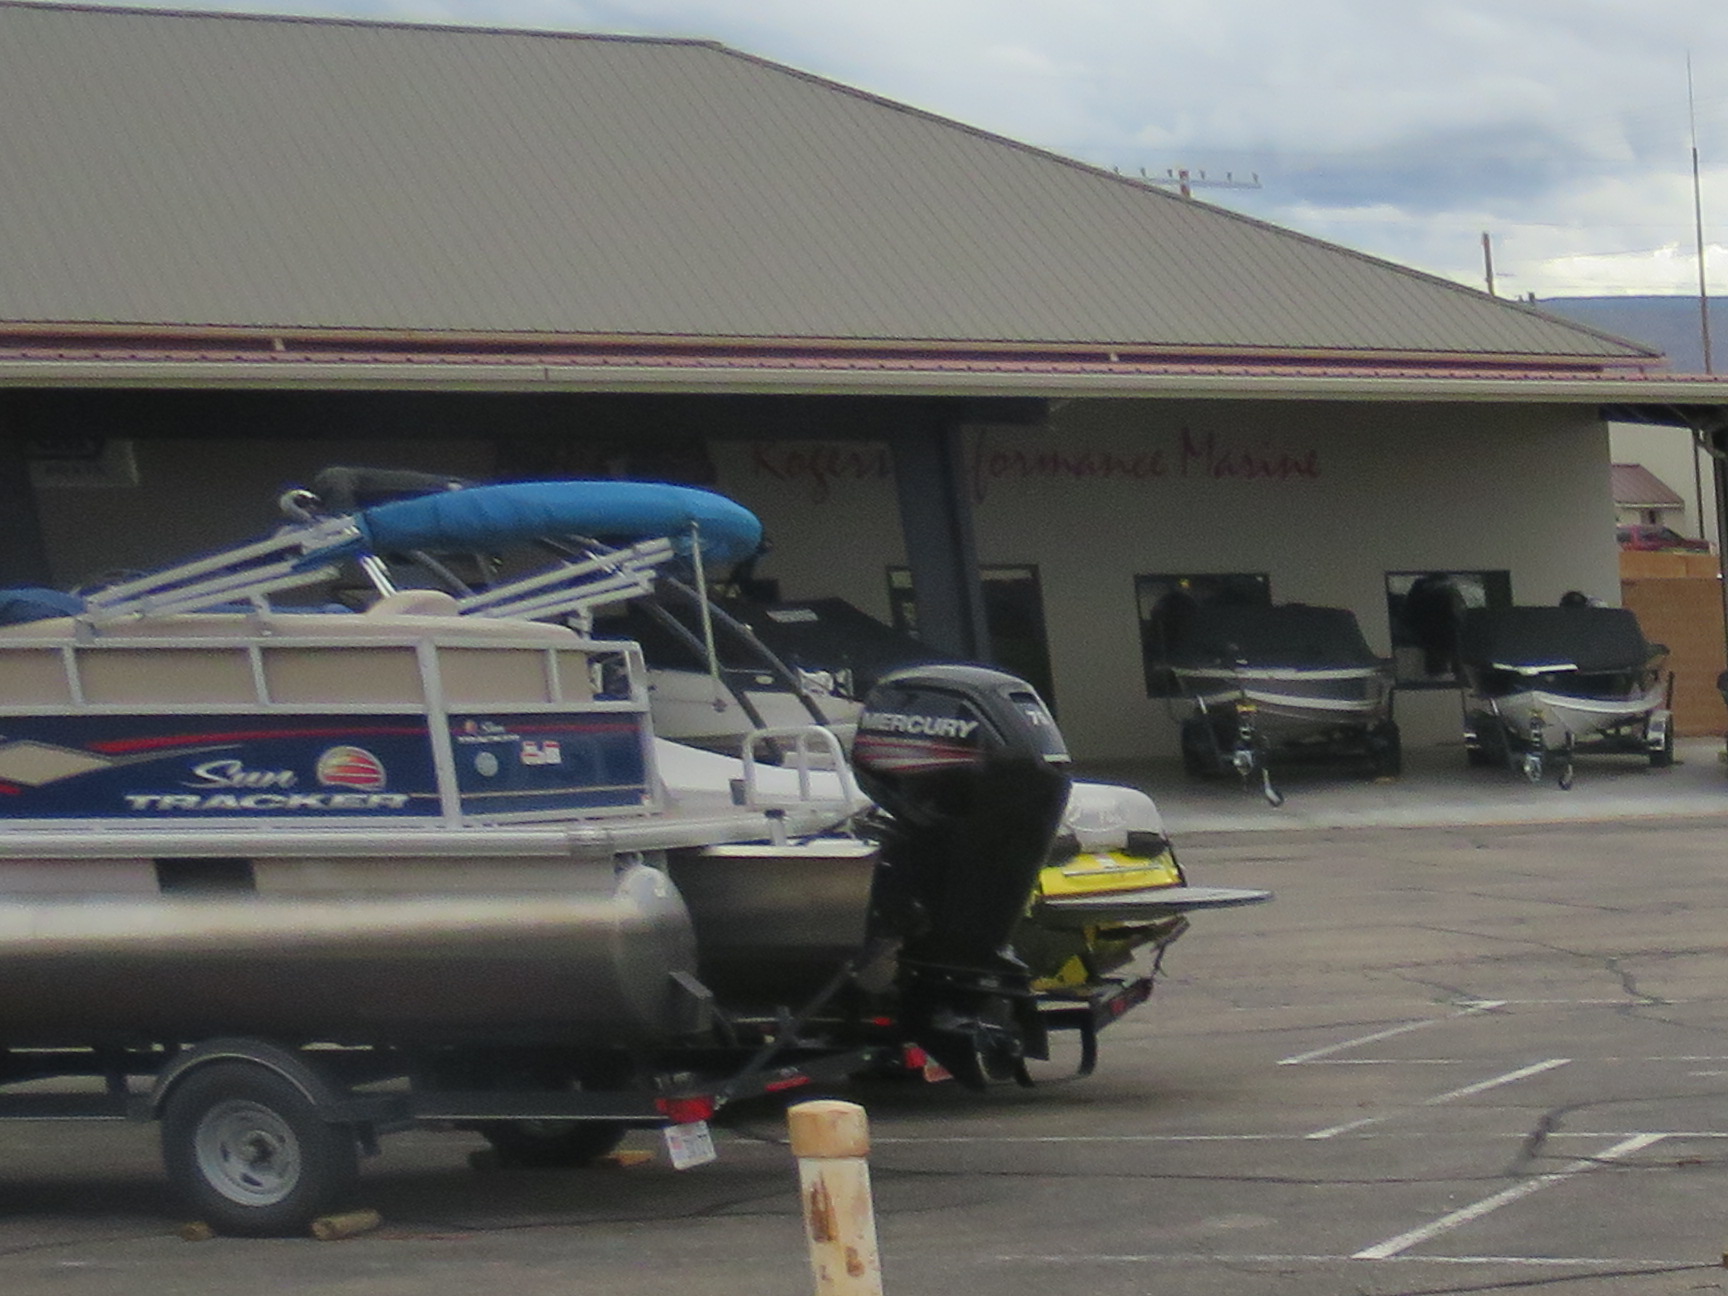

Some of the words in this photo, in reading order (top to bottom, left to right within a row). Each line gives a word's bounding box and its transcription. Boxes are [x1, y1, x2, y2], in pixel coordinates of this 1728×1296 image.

[1176, 425, 1322, 482] Marine
[862, 711, 979, 738] MERCURY
[182, 759, 298, 788] Sun
[124, 793, 410, 811] TRACKER
